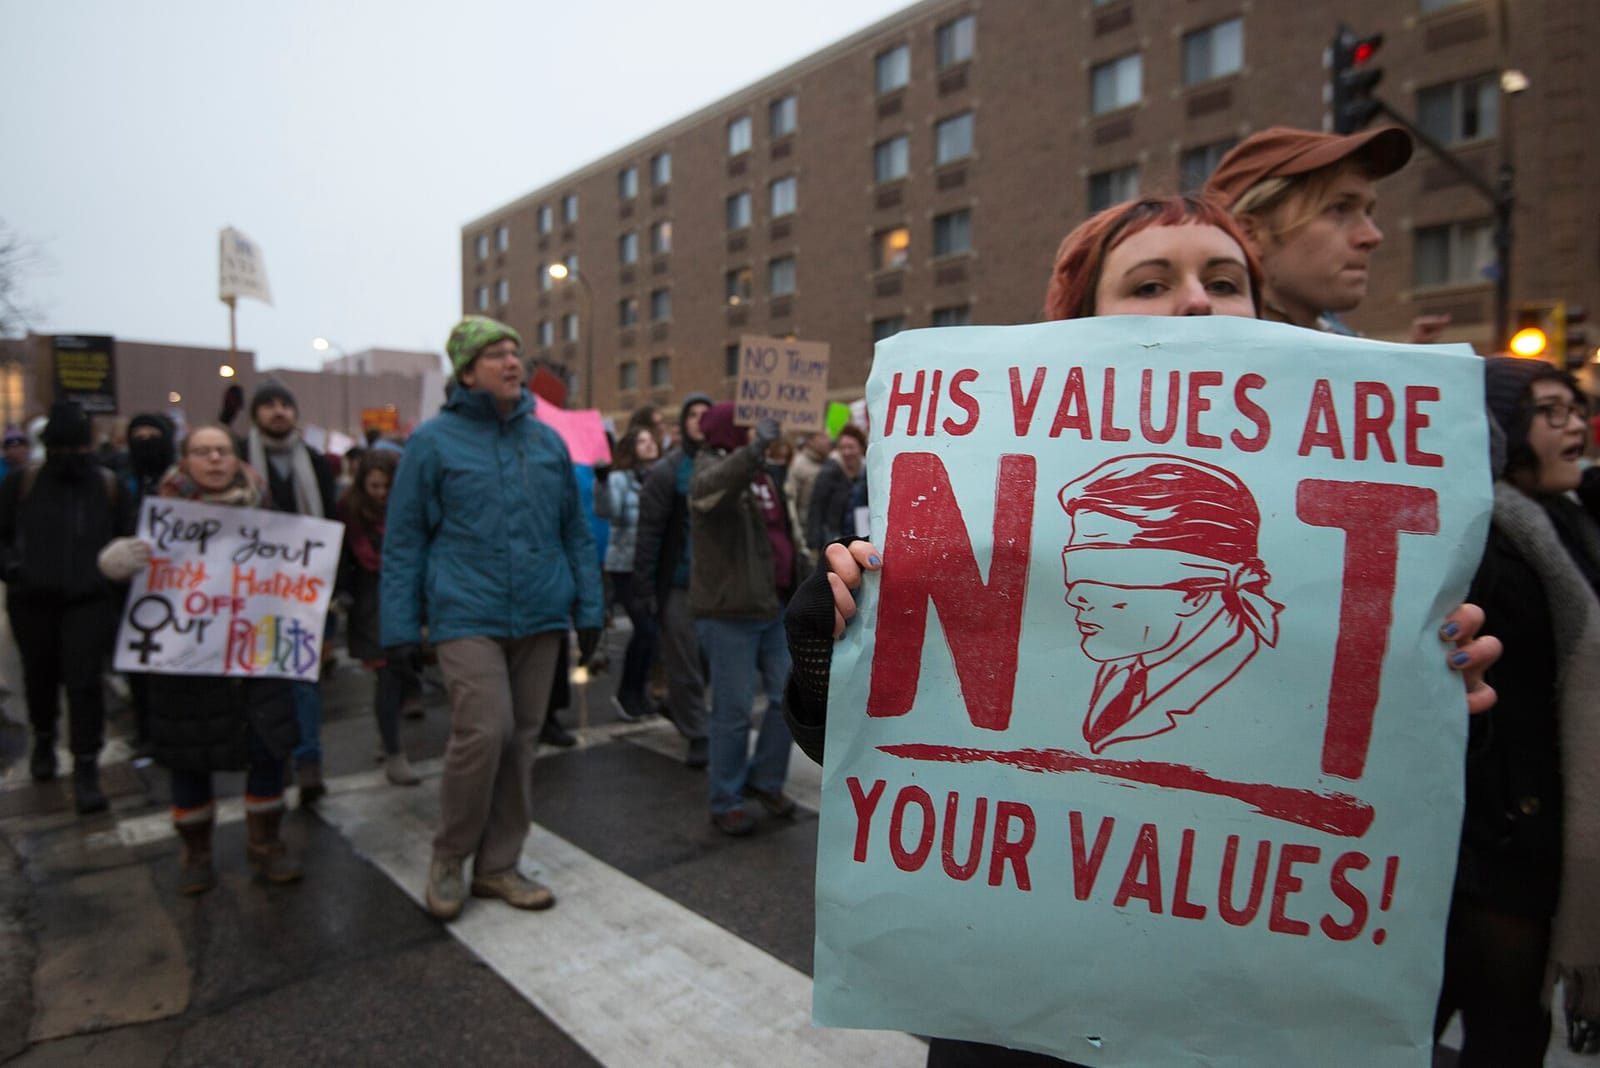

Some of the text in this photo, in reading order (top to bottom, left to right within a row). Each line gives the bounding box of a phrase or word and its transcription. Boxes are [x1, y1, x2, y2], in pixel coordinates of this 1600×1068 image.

[741, 379, 771, 400] NO
[884, 366, 1444, 467] HIS VALUES ARE
[149, 506, 324, 568] Keep your
[846, 777, 1399, 945] YOUR VALUES!
